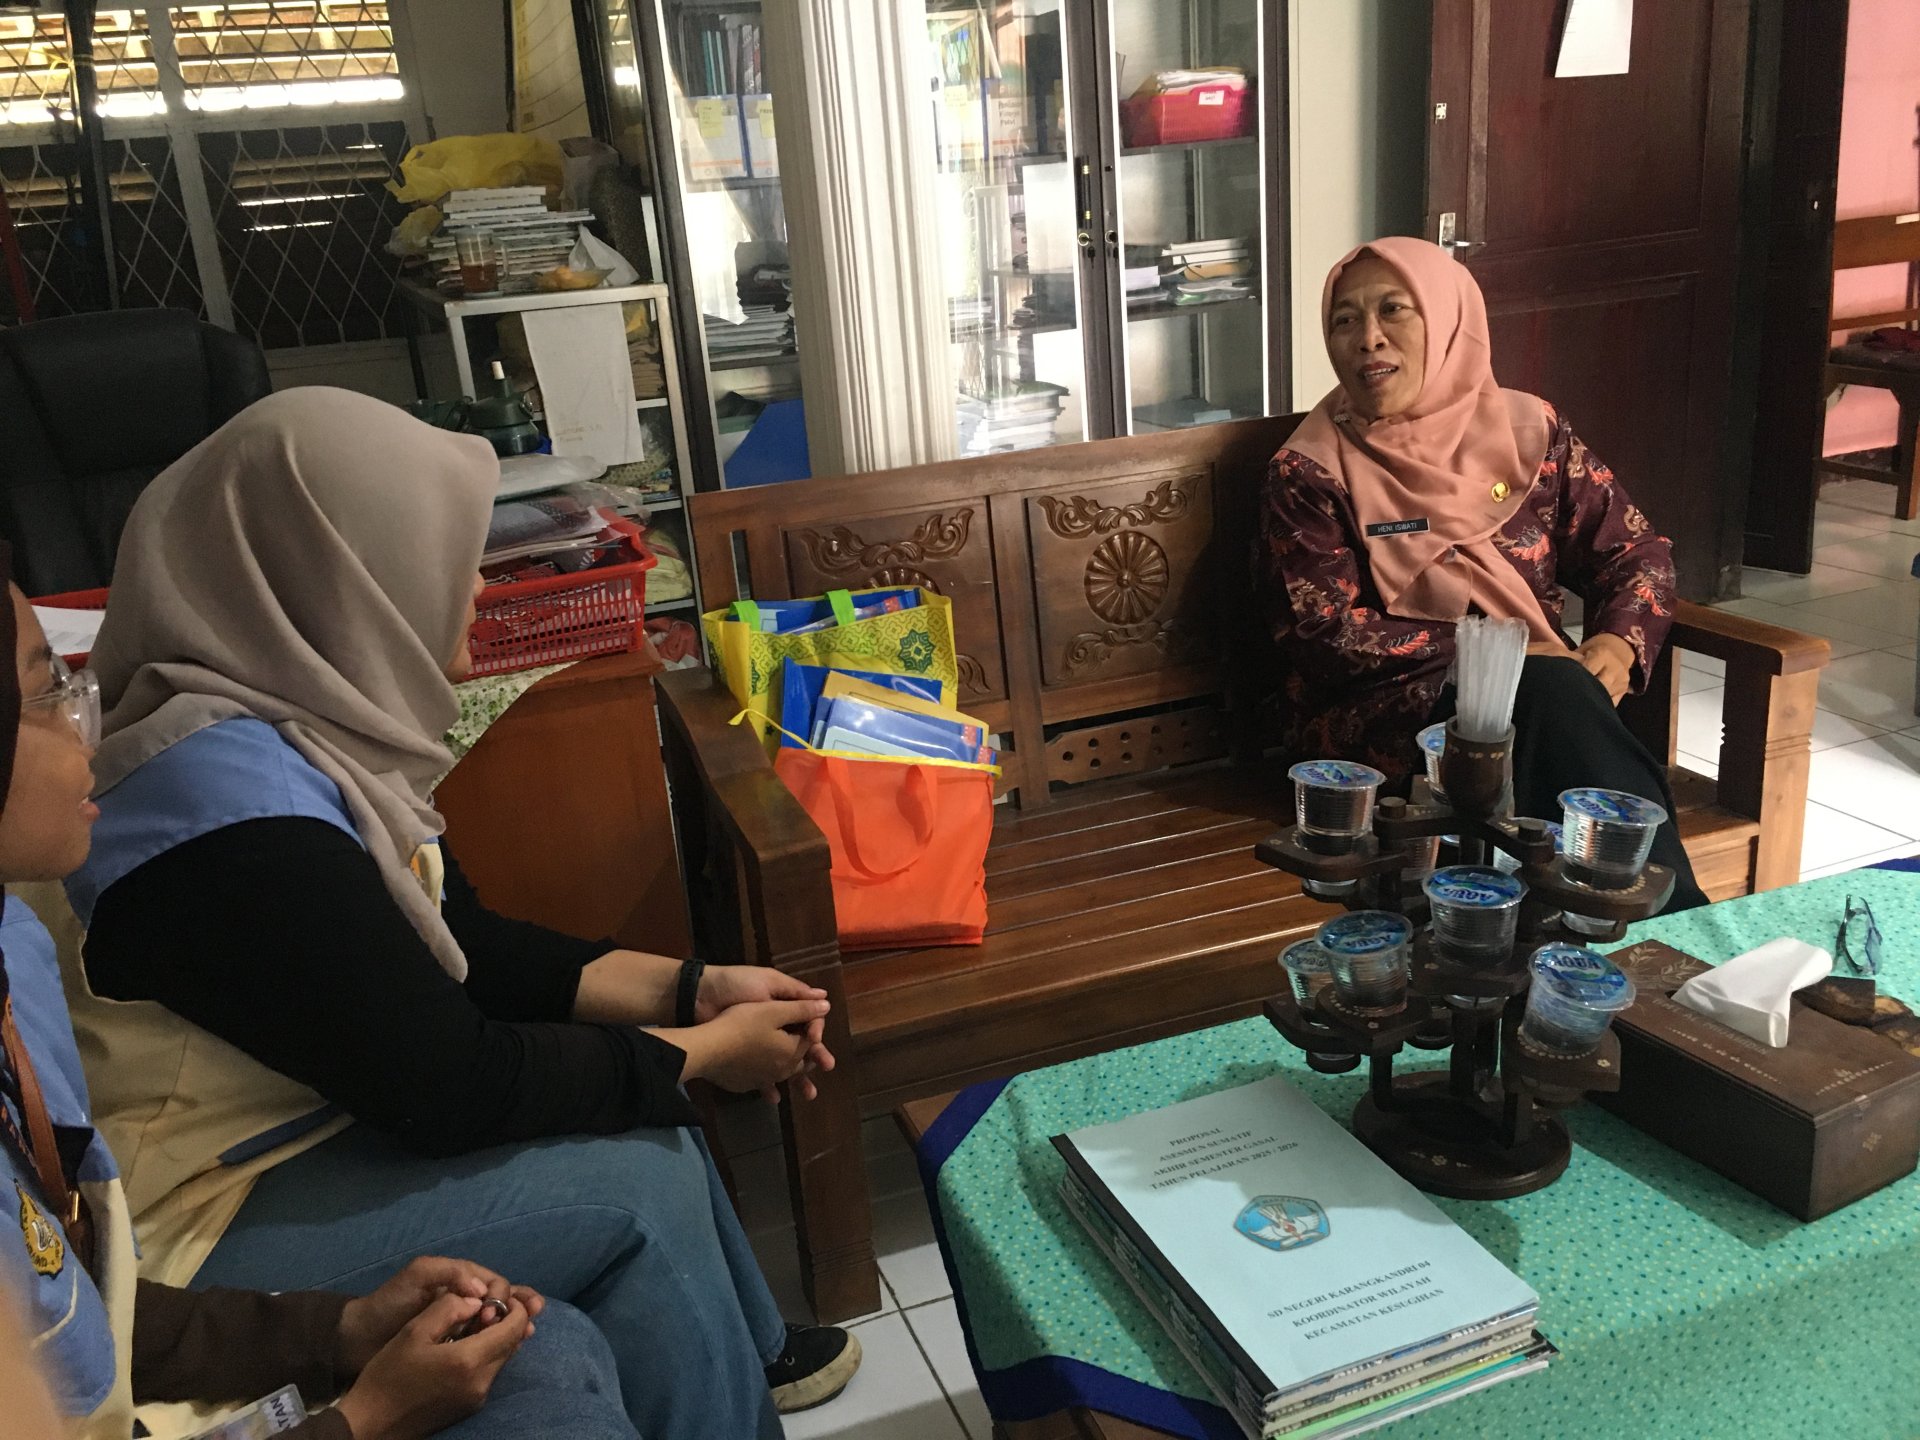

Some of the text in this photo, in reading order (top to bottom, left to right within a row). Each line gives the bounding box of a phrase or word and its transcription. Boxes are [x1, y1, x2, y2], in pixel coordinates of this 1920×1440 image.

[1377, 522, 1417, 533] HENI ISWATI
[1443, 887, 1494, 901] AQUA
[1552, 954, 1602, 970] AQUA
[1159, 1130, 1252, 1163] ASESMEN SUMATIF
[1169, 1127, 1223, 1147] PROPOSAL
[1150, 1175, 1189, 1191] TAHUN
[1188, 1156, 1250, 1179] PELAJARAN
[1251, 1149, 1273, 1161] 2025
[1277, 1141, 1299, 1152] 2026
[1153, 1135, 1279, 1177] AKHIR SEMESTER GASAL
[1267, 1260, 1432, 1319] SD NEGERI KARANGKANDRI 04
[1292, 1276, 1433, 1328] KOORDINATOR WILAYAH
[1303, 1288, 1445, 1341] KECAMATAN KESUGIHAN
